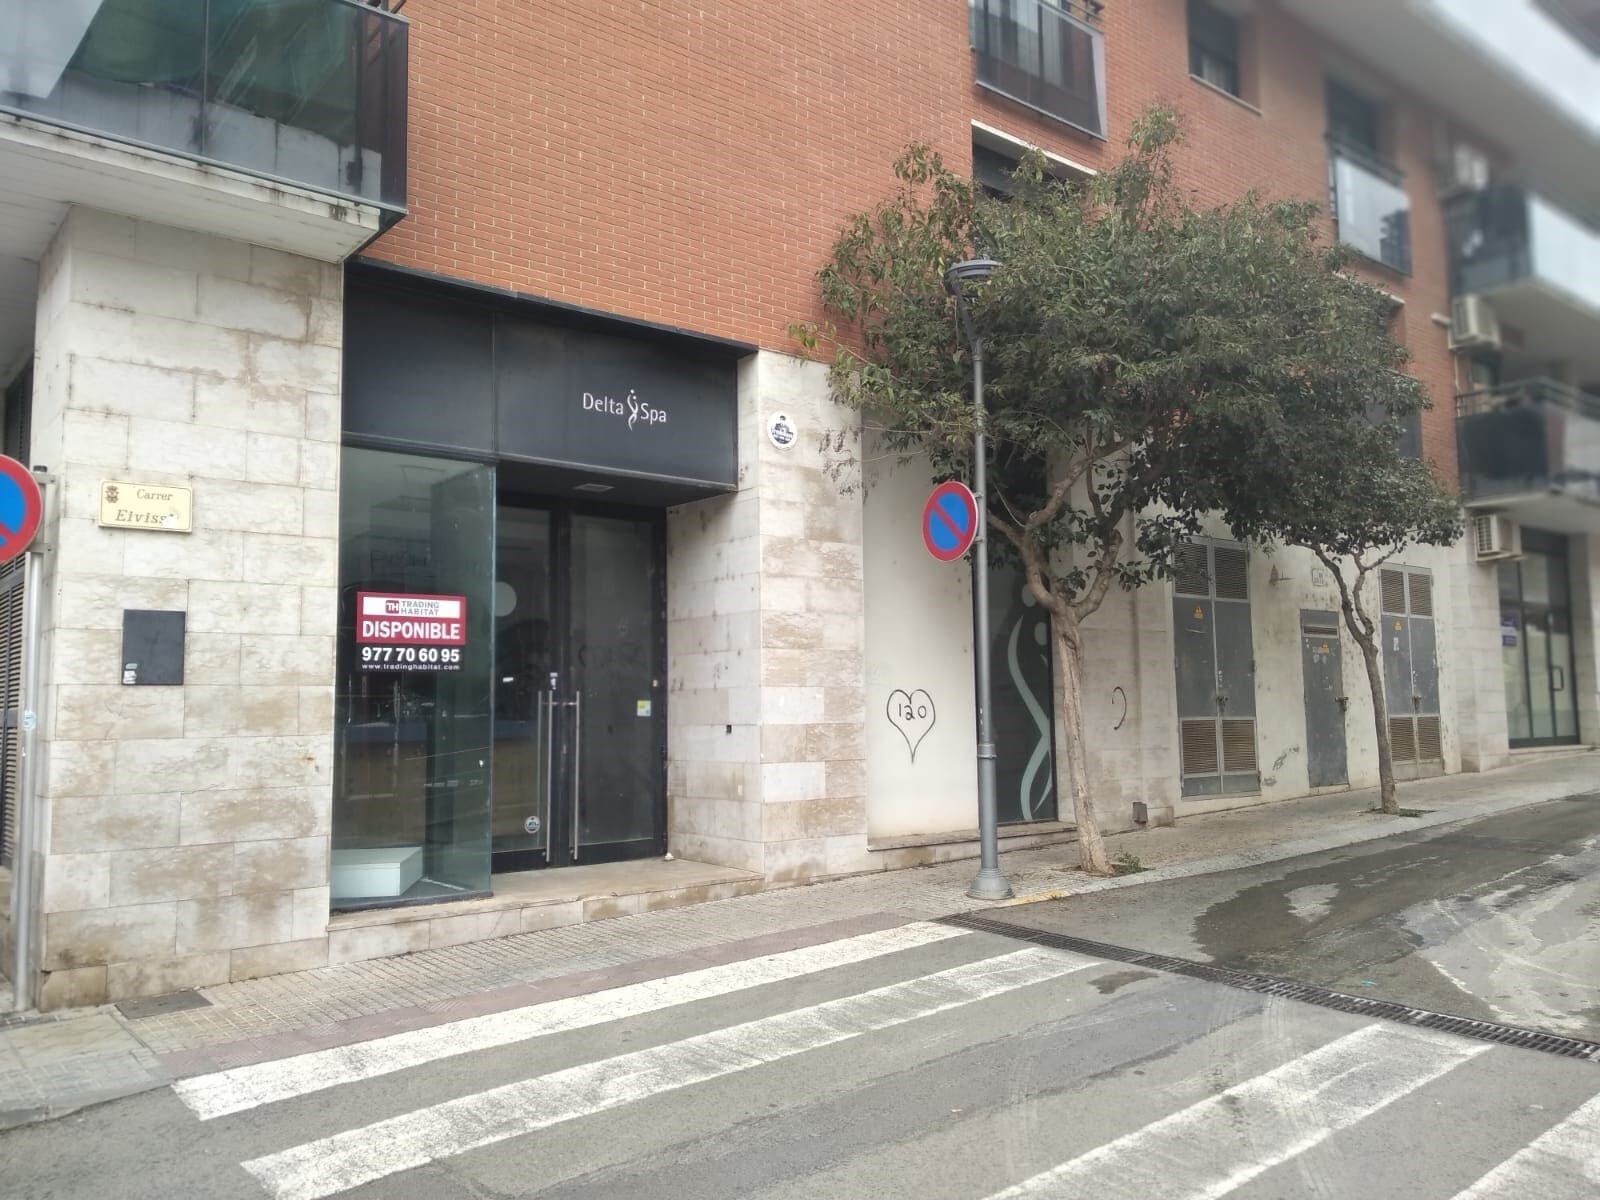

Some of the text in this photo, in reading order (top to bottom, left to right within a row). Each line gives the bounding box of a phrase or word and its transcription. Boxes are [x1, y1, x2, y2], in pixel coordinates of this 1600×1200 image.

[583, 392, 667, 425] Delta Spa
[136, 488, 174, 501] Carrer
[115, 509, 174, 525] Eiviss
[386, 601, 399, 612] TH
[401, 600, 439, 608] TRADING
[401, 608, 439, 616] HABITAT
[362, 620, 460, 639] DISPONIBLE
[362, 647, 460, 662] 977 70 60 95
[362, 663, 460, 671] www.tradinghabitat.com
